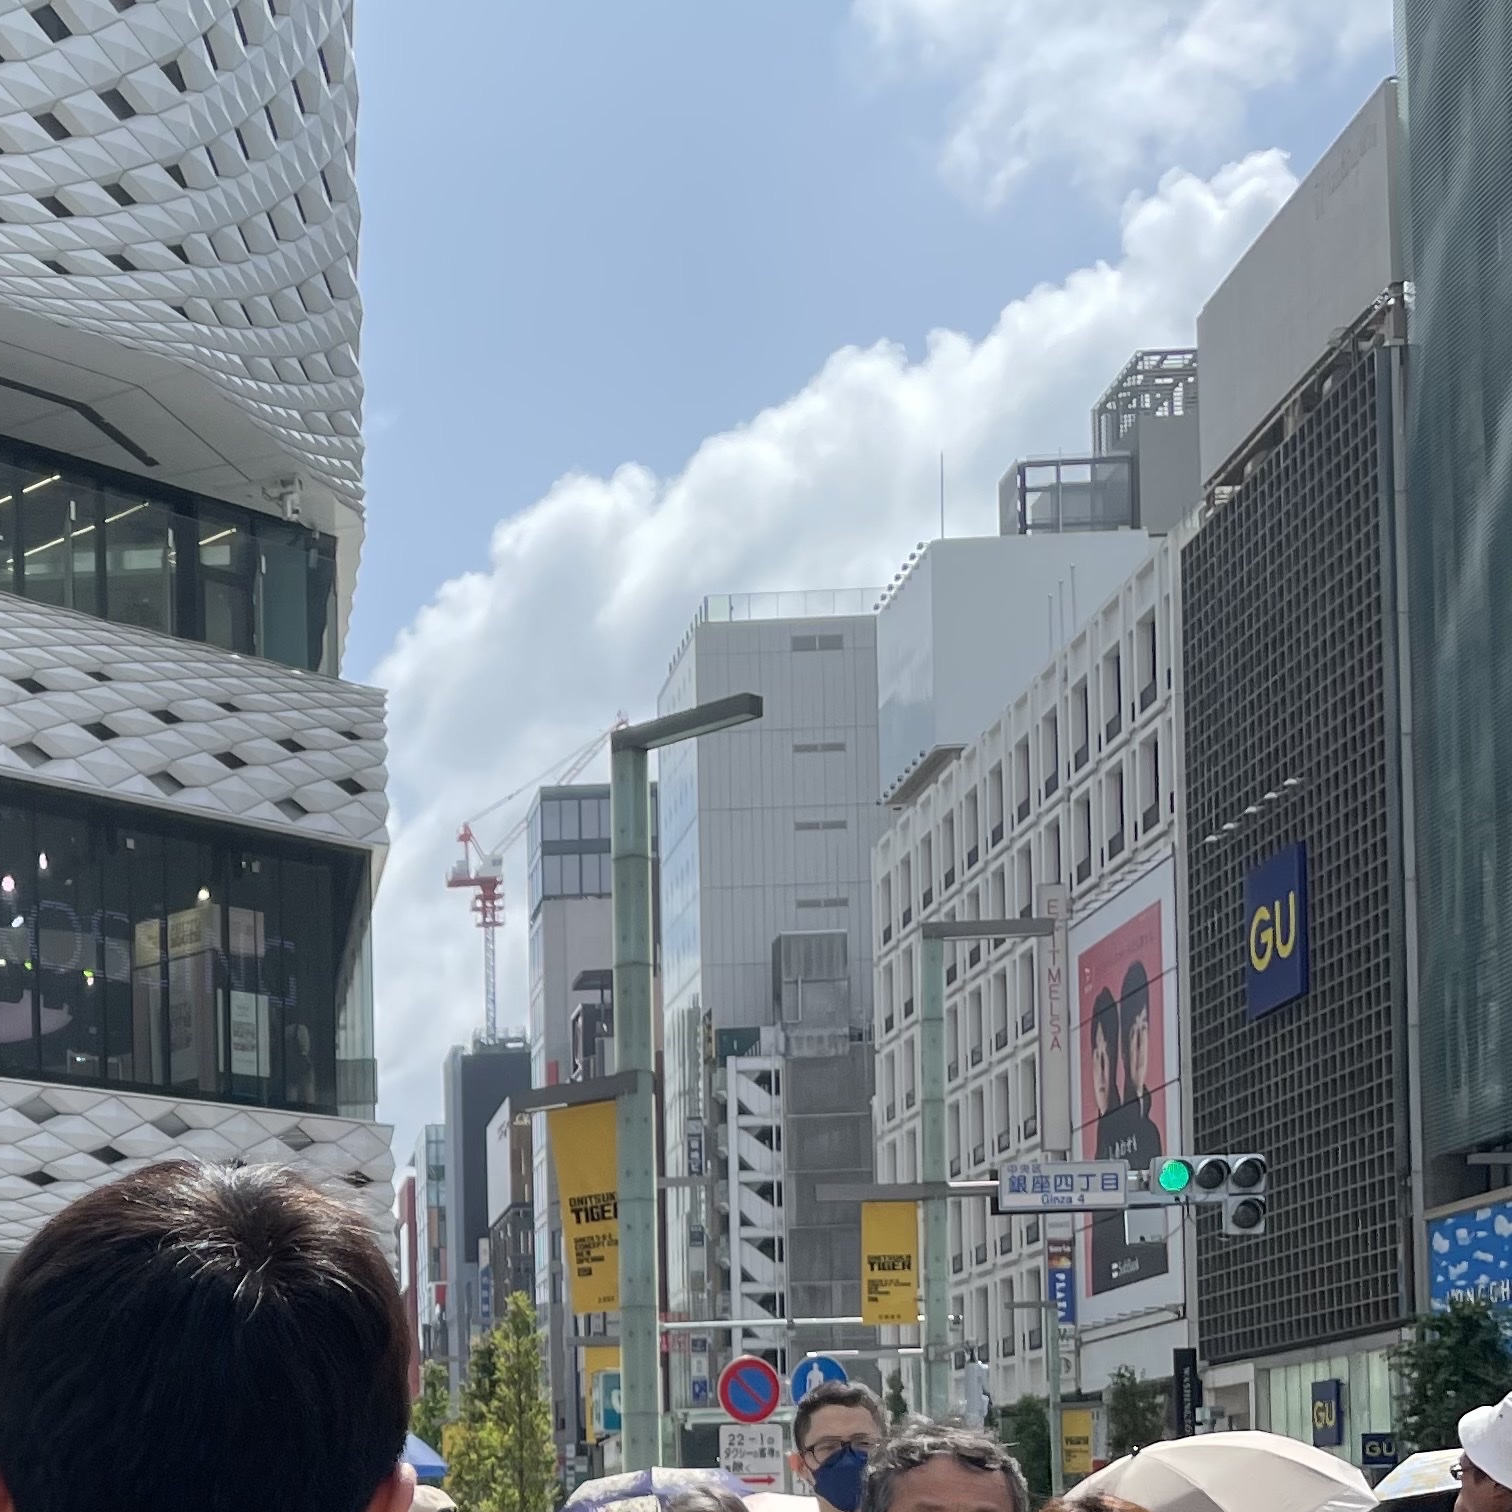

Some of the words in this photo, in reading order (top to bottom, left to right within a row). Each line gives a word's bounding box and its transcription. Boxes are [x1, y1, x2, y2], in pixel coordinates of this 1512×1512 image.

[1250, 890, 1296, 972] GU
[1047, 899, 1061, 1051] EITMELSA
[1009, 1173, 1119, 1193] 銀座四丁目
[569, 1192, 616, 1208] ONITSUK
[1041, 1194, 1073, 1205] Ginza
[1077, 1194, 1085, 1205] 4
[571, 1202, 618, 1225] TIGE
[1313, 1400, 1335, 1430] GU
[1365, 1440, 1395, 1457] GU
